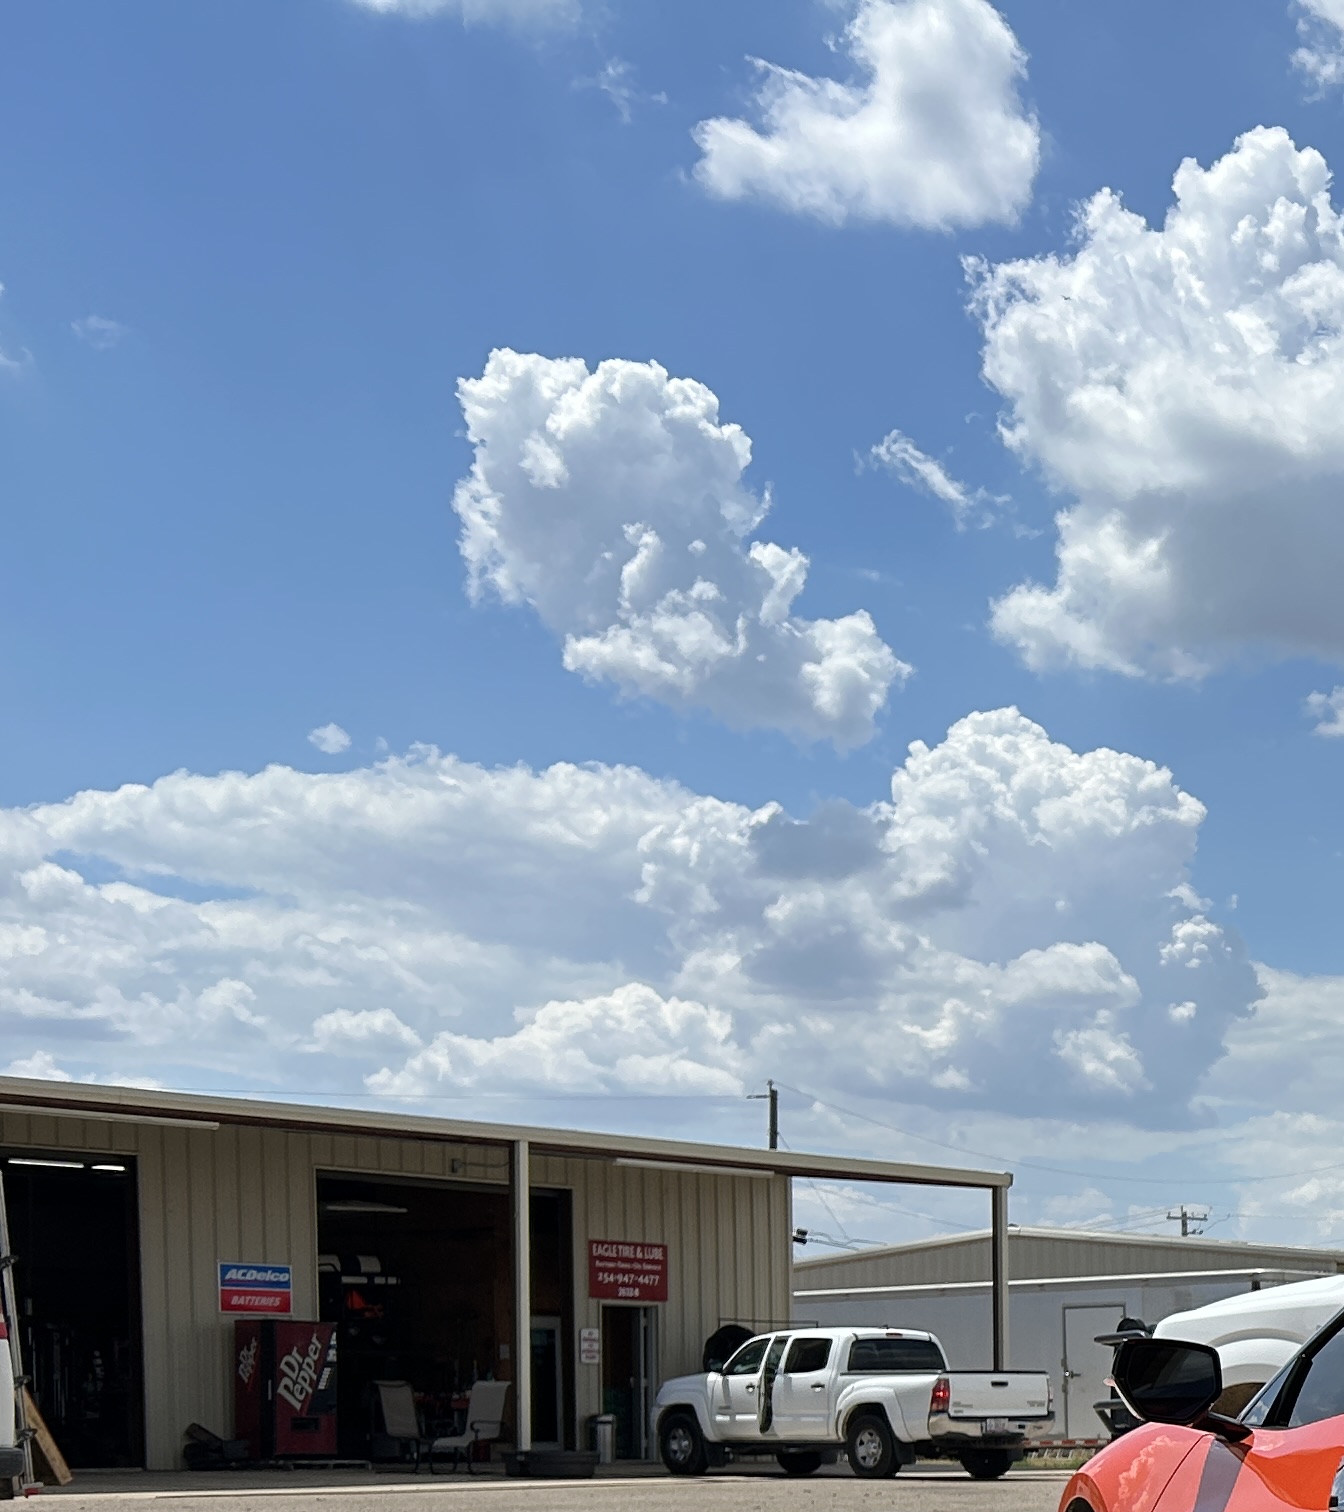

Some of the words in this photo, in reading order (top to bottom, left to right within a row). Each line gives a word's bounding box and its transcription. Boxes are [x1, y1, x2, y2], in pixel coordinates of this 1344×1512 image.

[592, 1243, 617, 1257] EAGLE
[618, 1244, 635, 1258] TIRE
[636, 1246, 643, 1259] &
[644, 1246, 664, 1260] LUBE
[224, 1268, 290, 1282] ACDelco
[230, 1295, 281, 1307] BATTERIES
[280, 1346, 303, 1380] Dr
[276, 1333, 321, 1411] Pepper
